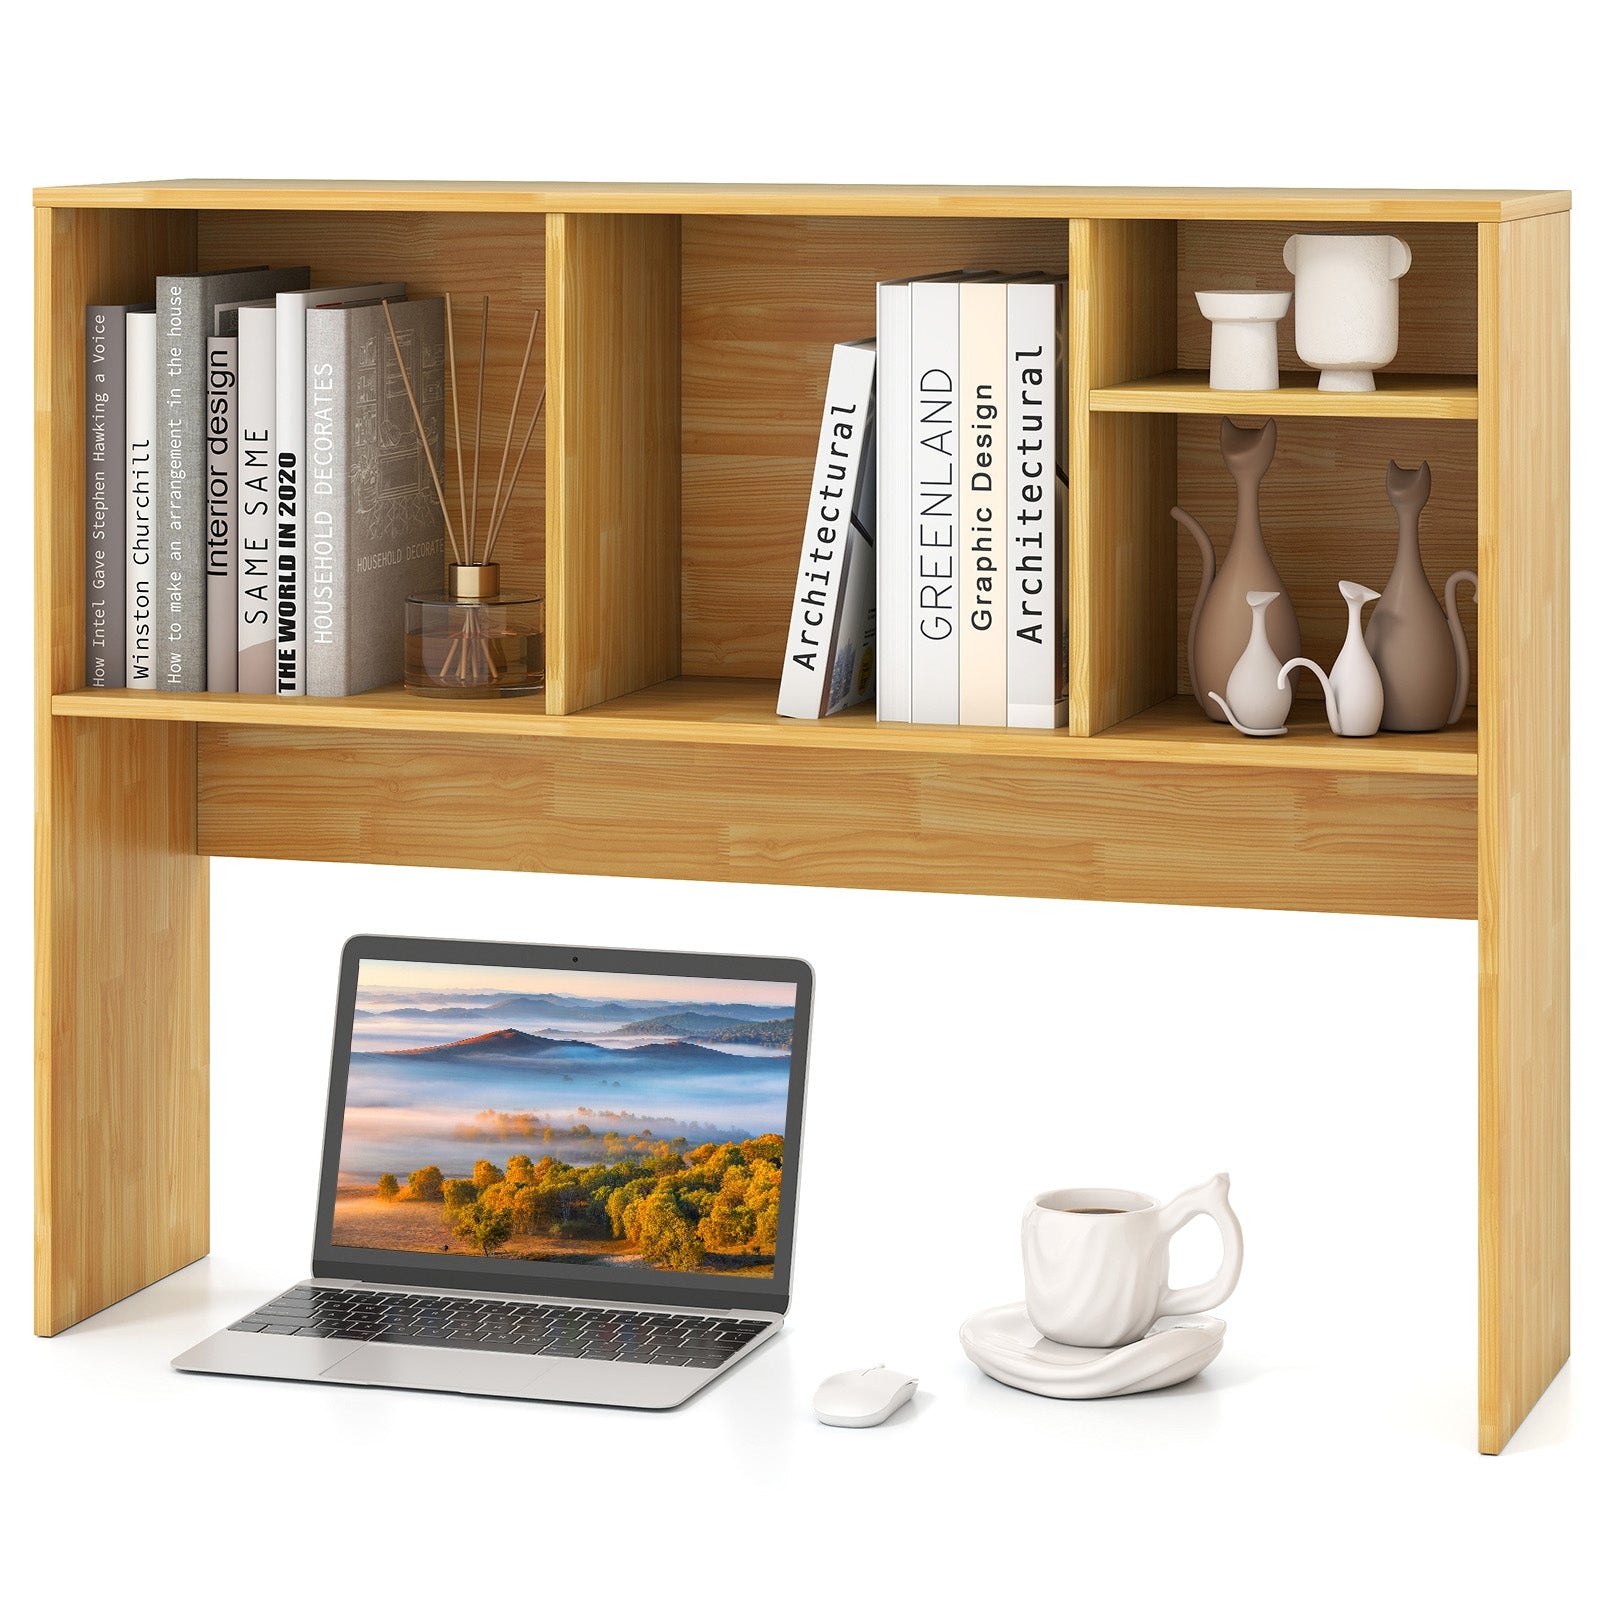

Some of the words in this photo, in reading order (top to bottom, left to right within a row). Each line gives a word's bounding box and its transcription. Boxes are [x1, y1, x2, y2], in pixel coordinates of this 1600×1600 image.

[92, 314, 105, 363] Voice
[167, 286, 182, 336] house
[95, 373, 105, 382] a
[167, 347, 182, 377] the
[92, 392, 108, 462] Hawking
[167, 388, 182, 407] in
[207, 350, 235, 455] design
[314, 363, 333, 495] DECORATES
[972, 384, 997, 491] Design
[93, 471, 108, 539] Stephen
[132, 440, 149, 565] Churchill
[168, 419, 186, 530] arrangement
[245, 429, 268, 515] SAME
[279, 452, 297, 516] 2020
[920, 368, 952, 640] GREENLAND
[1015, 345, 1043, 644] Architectural
[171, 541, 182, 560] an
[207, 465, 228, 576] Interior
[279, 523, 296, 547] IN
[793, 404, 856, 671] Architectural
[93, 550, 105, 589] Gave
[167, 571, 182, 612] make
[245, 538, 268, 624] SAME
[314, 511, 333, 644] HOUSEHOLD
[357, 548, 402, 572] HOUSEHOLD
[971, 507, 997, 630] Graphic
[92, 600, 105, 647] Intel
[132, 581, 149, 679] Winston
[168, 622, 182, 641] to
[279, 554, 297, 643] WORLD
[93, 656, 105, 687] How
[168, 652, 182, 683] How
[279, 649, 296, 693] THE
